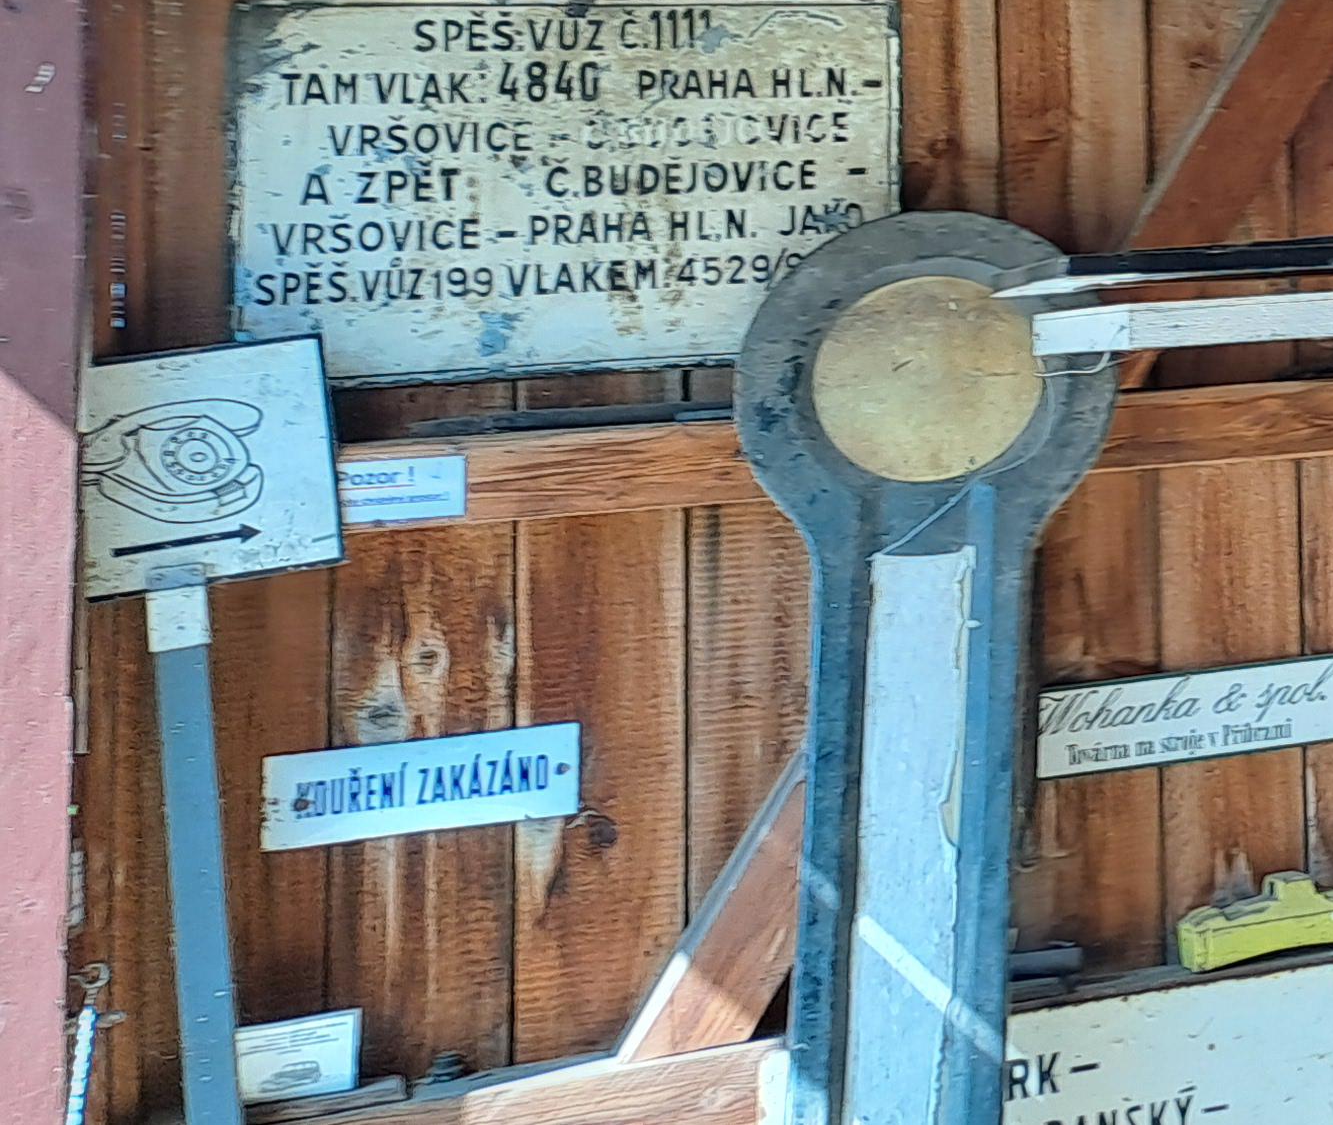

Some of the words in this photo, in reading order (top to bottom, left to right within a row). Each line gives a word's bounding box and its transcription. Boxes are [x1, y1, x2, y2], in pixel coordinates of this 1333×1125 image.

[279, 72, 360, 106] TAM
[496, 60, 600, 103] 4840
[637, 68, 758, 101] PRAHA
[328, 115, 535, 157] VRŠOVICE
[299, 172, 332, 206] A
[527, 212, 651, 246] PRAHA
[1210, 681, 1247, 715] &
[295, 761, 409, 820] KOUŘENÍ
[415, 750, 549, 805] ZAKÁZÁNO
[1005, 1052, 1061, 1102] RK
